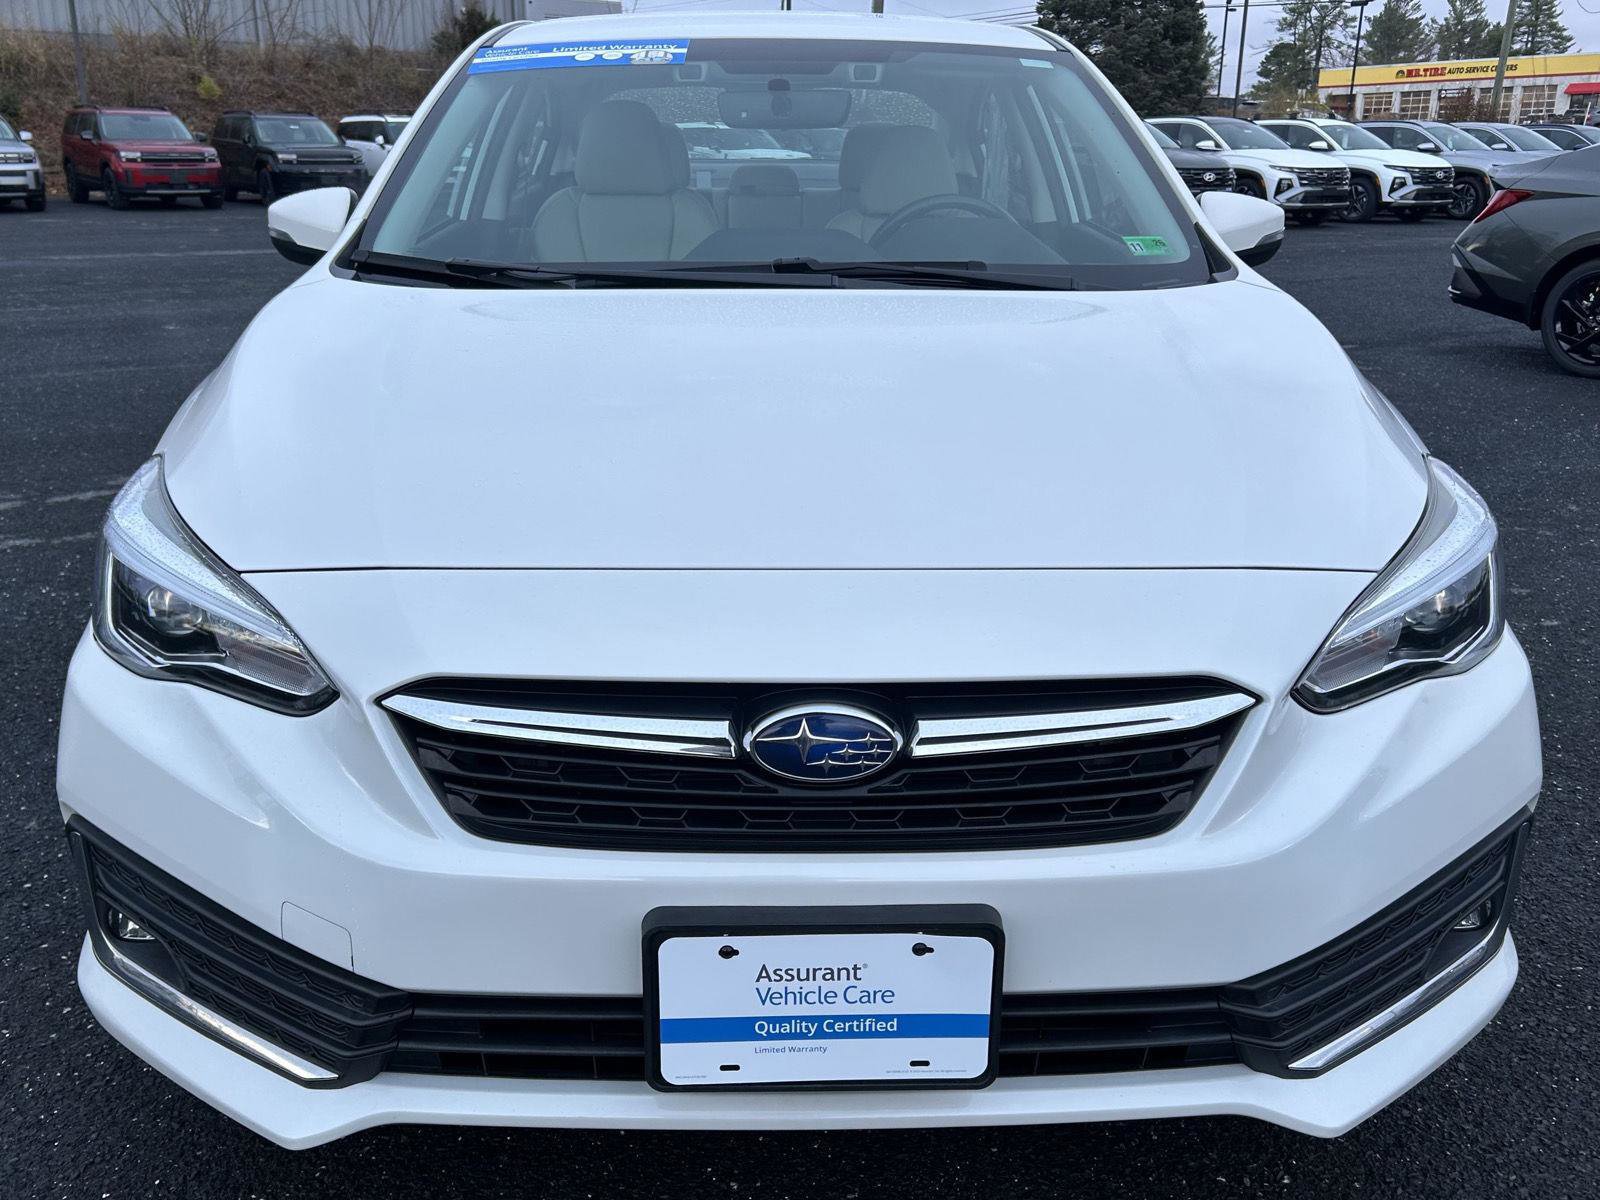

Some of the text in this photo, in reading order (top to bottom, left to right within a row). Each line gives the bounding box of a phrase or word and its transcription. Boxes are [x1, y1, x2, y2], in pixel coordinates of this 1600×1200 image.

[552, 45, 606, 53] Limited
[1447, 67, 1465, 75] AUTO
[1465, 65, 1490, 73] SERVICE
[1490, 64, 1518, 72] CERS
[1130, 243, 1144, 252] 11
[755, 985, 895, 1006] Vehicle Care
[754, 1018, 898, 1036] Quality Certified
[754, 1045, 828, 1055] Limited Warranty
